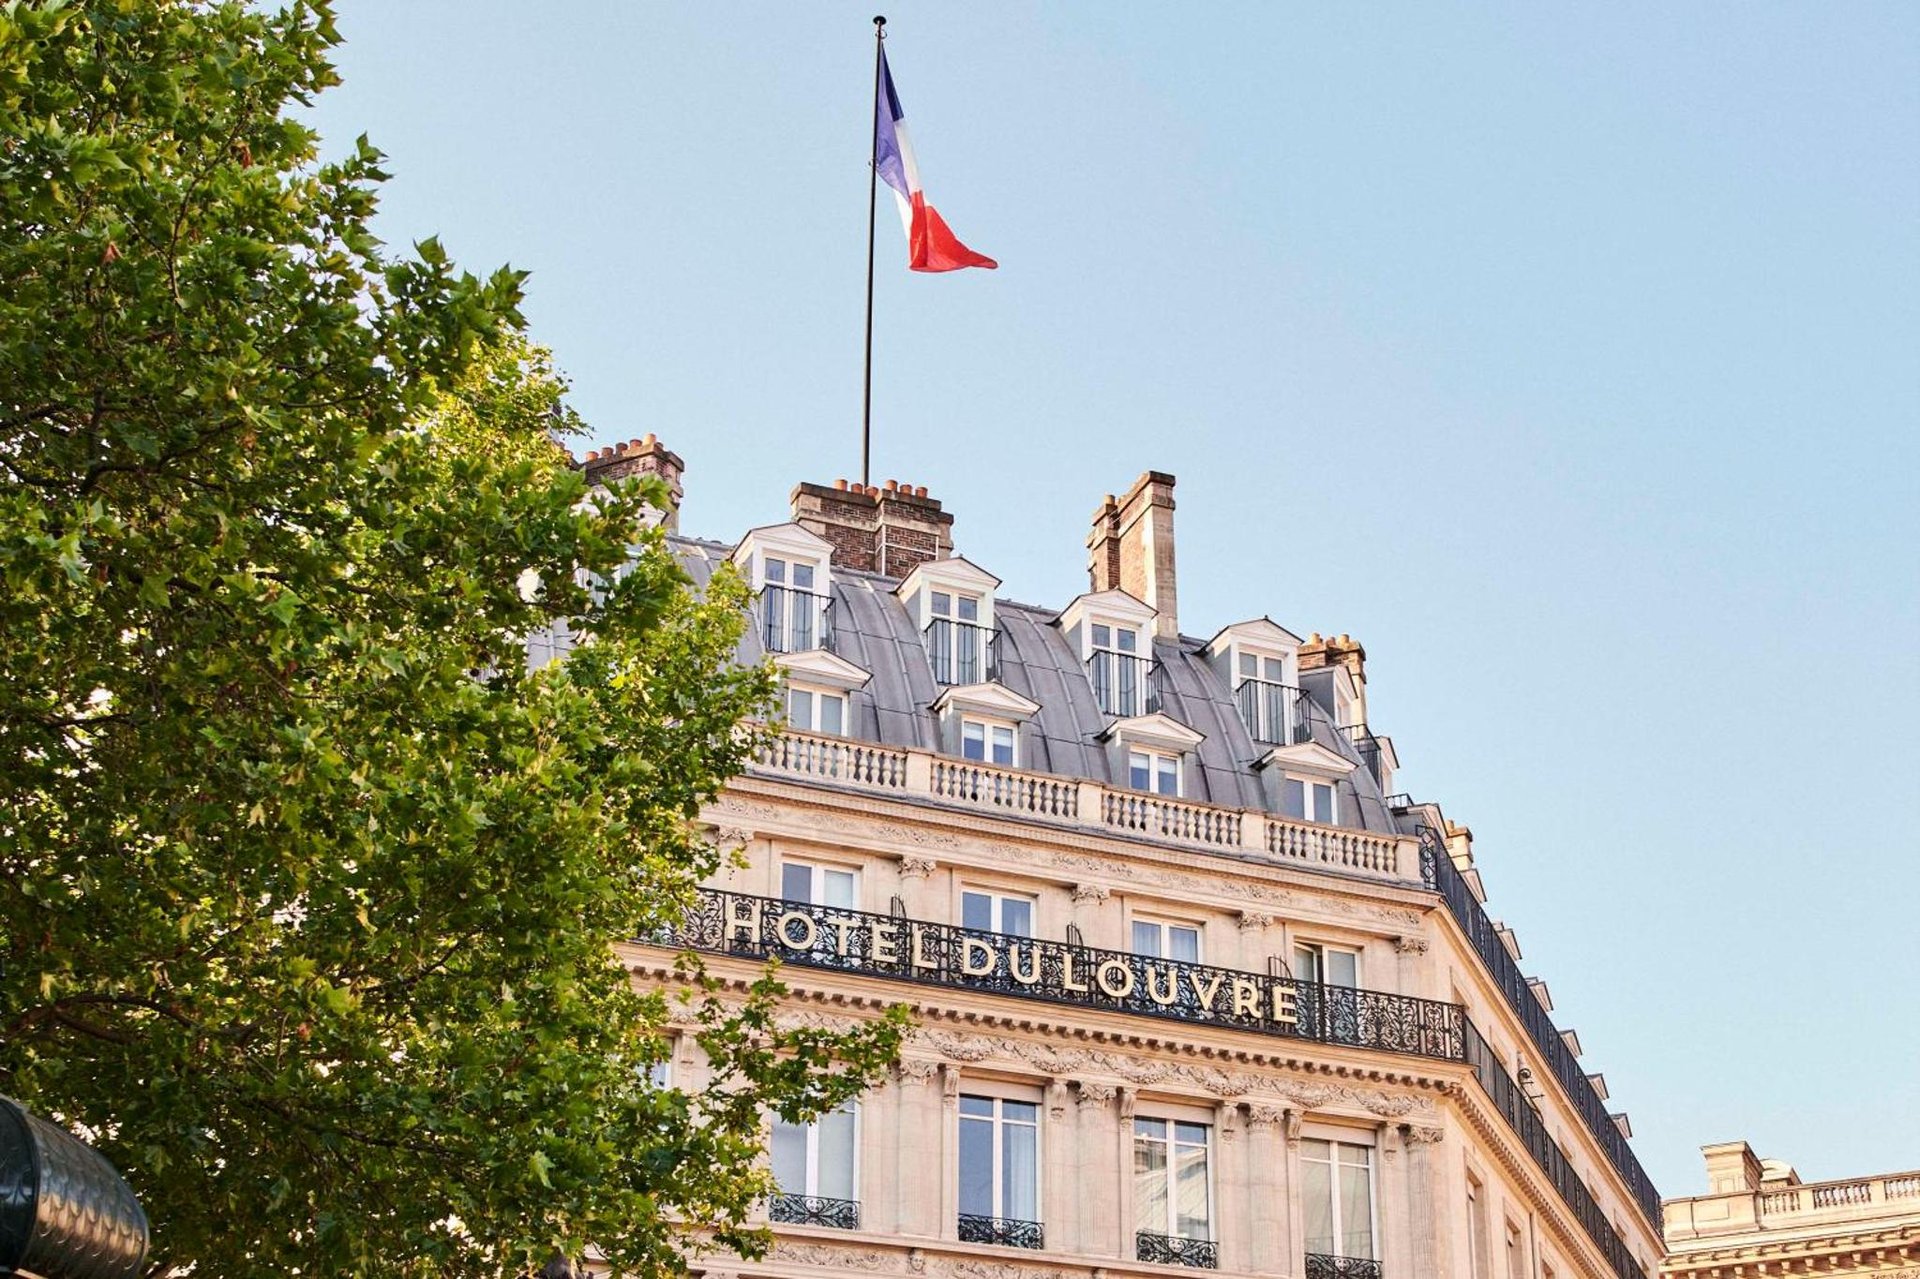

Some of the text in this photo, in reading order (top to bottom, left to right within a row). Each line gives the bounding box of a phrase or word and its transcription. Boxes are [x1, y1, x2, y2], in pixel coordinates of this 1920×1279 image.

[724, 899, 1298, 1023] HOTEL DU LOUVRE
